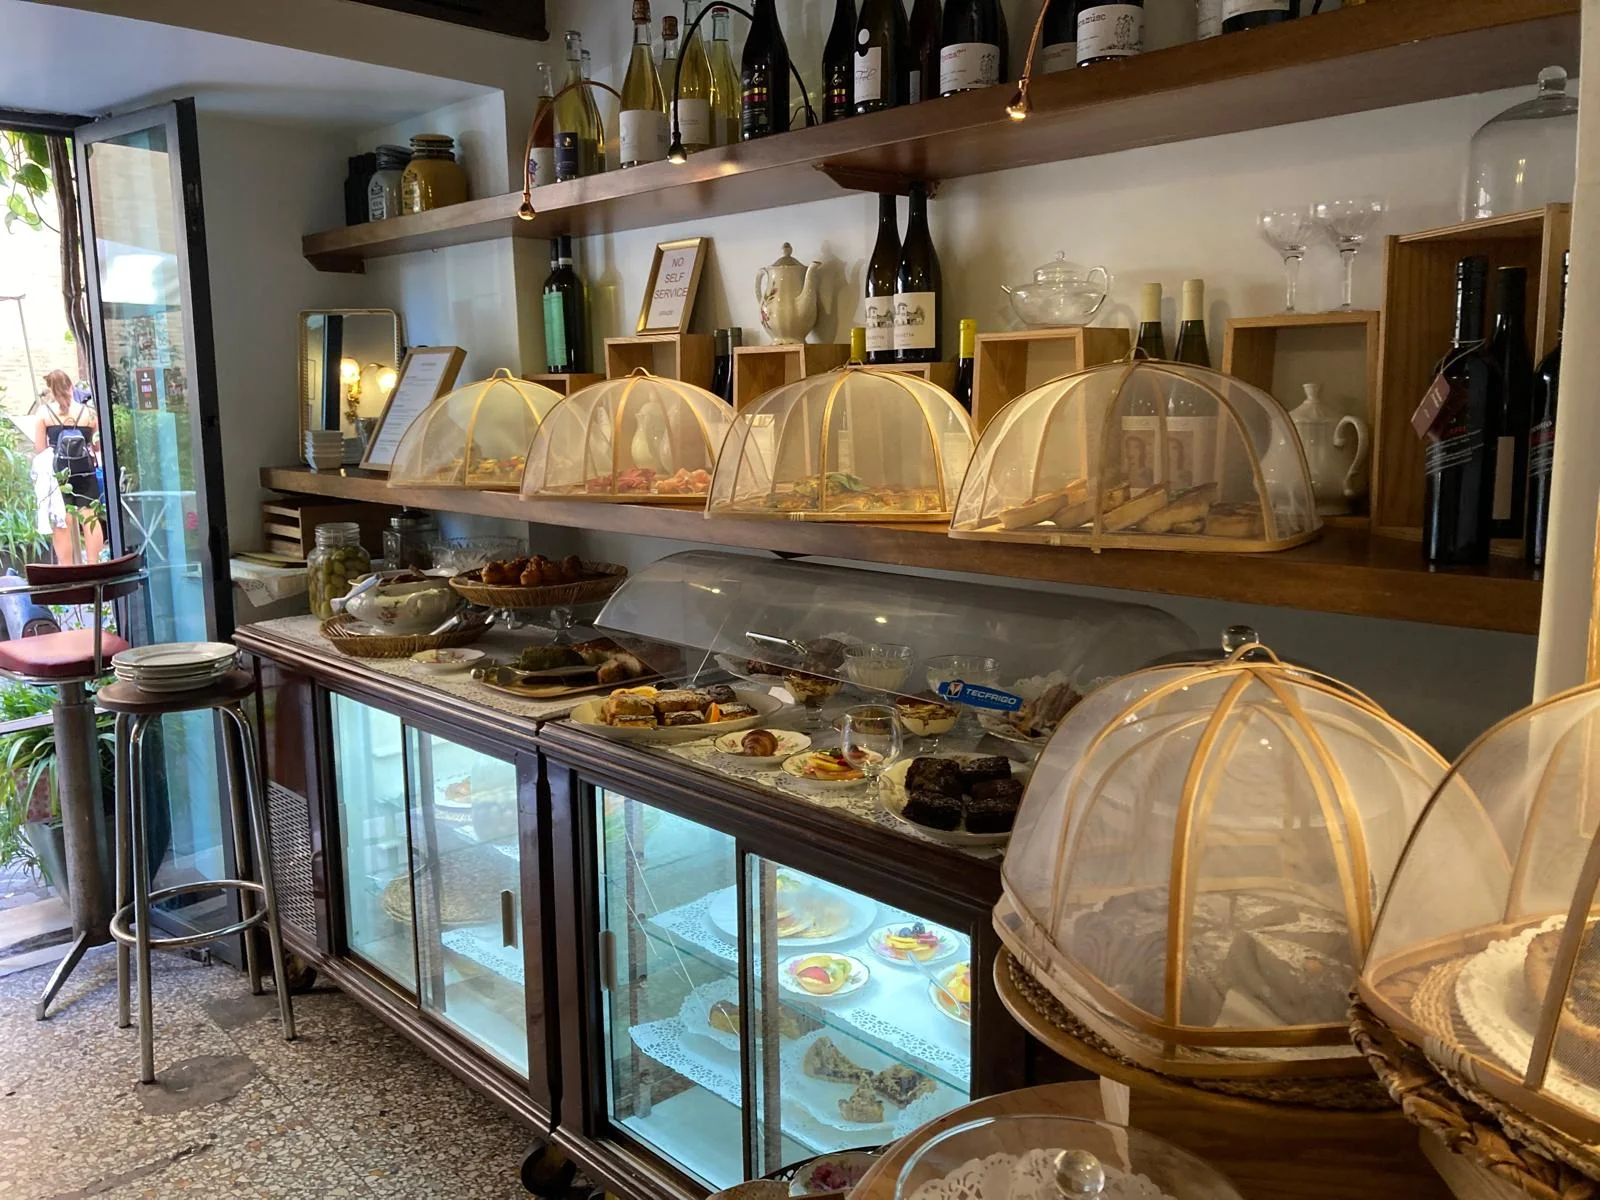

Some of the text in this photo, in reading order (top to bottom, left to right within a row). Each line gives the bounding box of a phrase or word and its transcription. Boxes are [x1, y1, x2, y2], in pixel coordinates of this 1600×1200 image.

[671, 257, 685, 267] NO
[664, 272, 685, 284] SELF
[653, 287, 688, 299] SERVICE
[965, 687, 1017, 705] TECFRIGO
